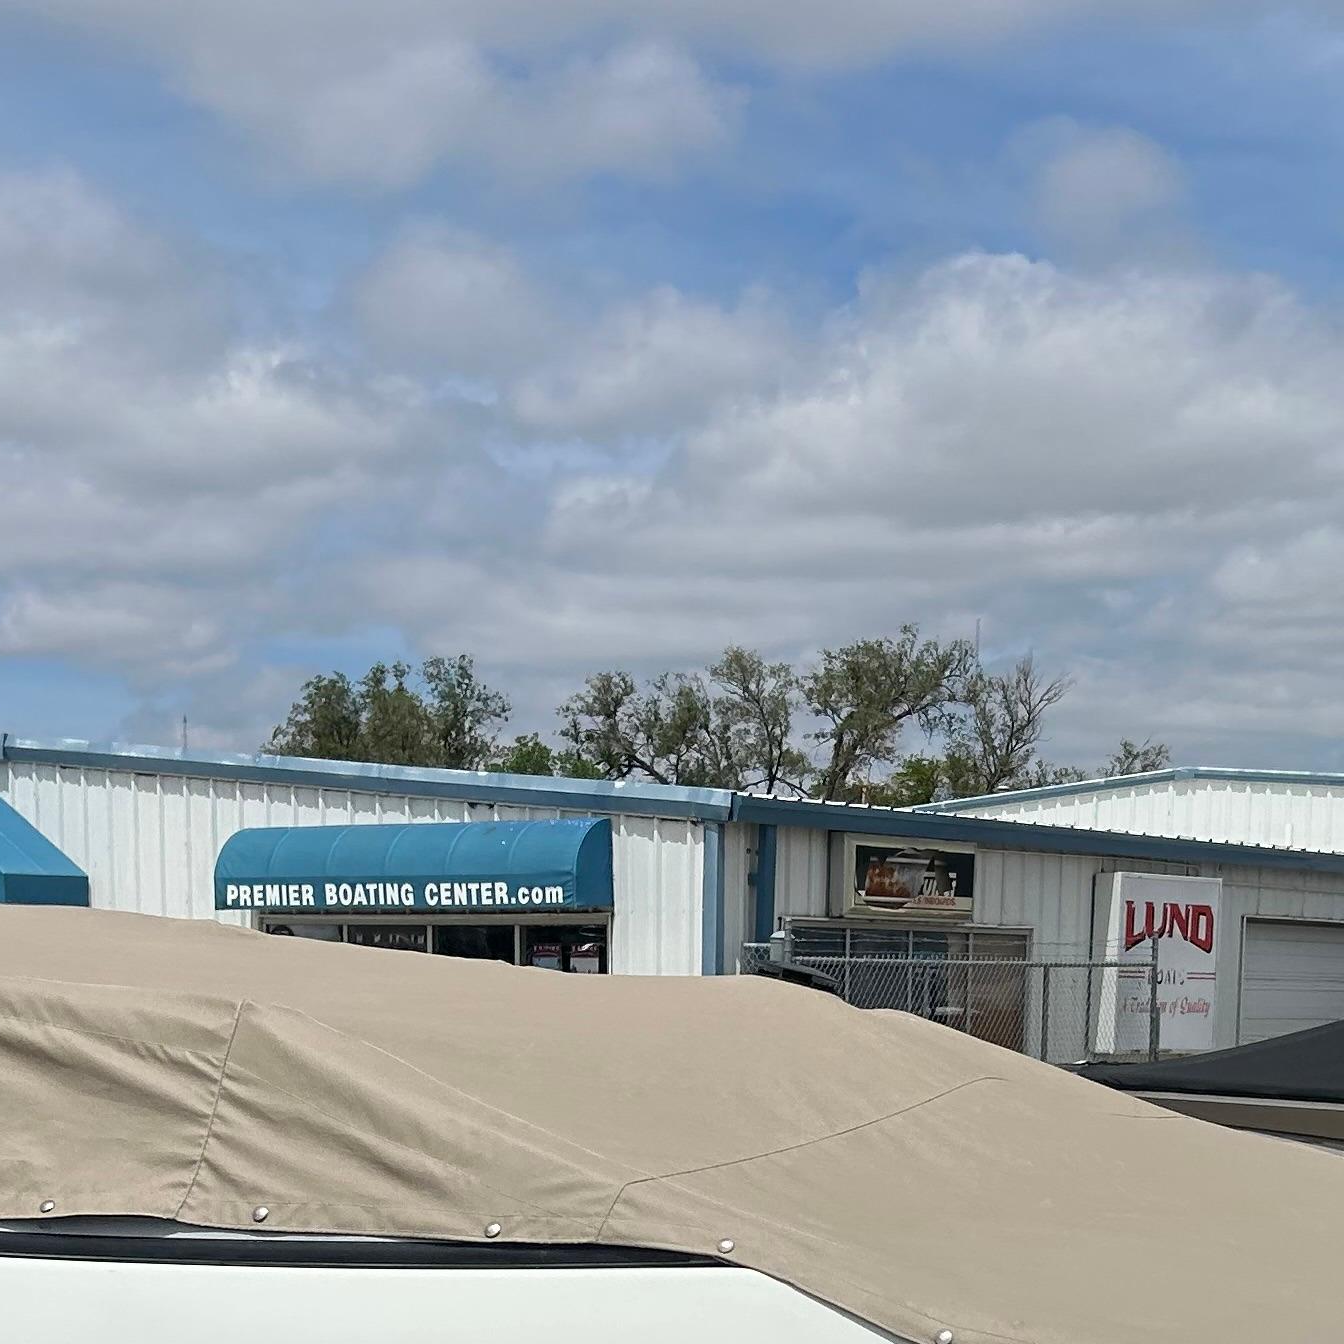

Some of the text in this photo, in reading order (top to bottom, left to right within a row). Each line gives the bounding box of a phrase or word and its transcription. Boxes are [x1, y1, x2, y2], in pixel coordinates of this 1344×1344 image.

[226, 882, 564, 906] PREMIER BOATING CENTER.com
[1124, 900, 1214, 954] LUND
